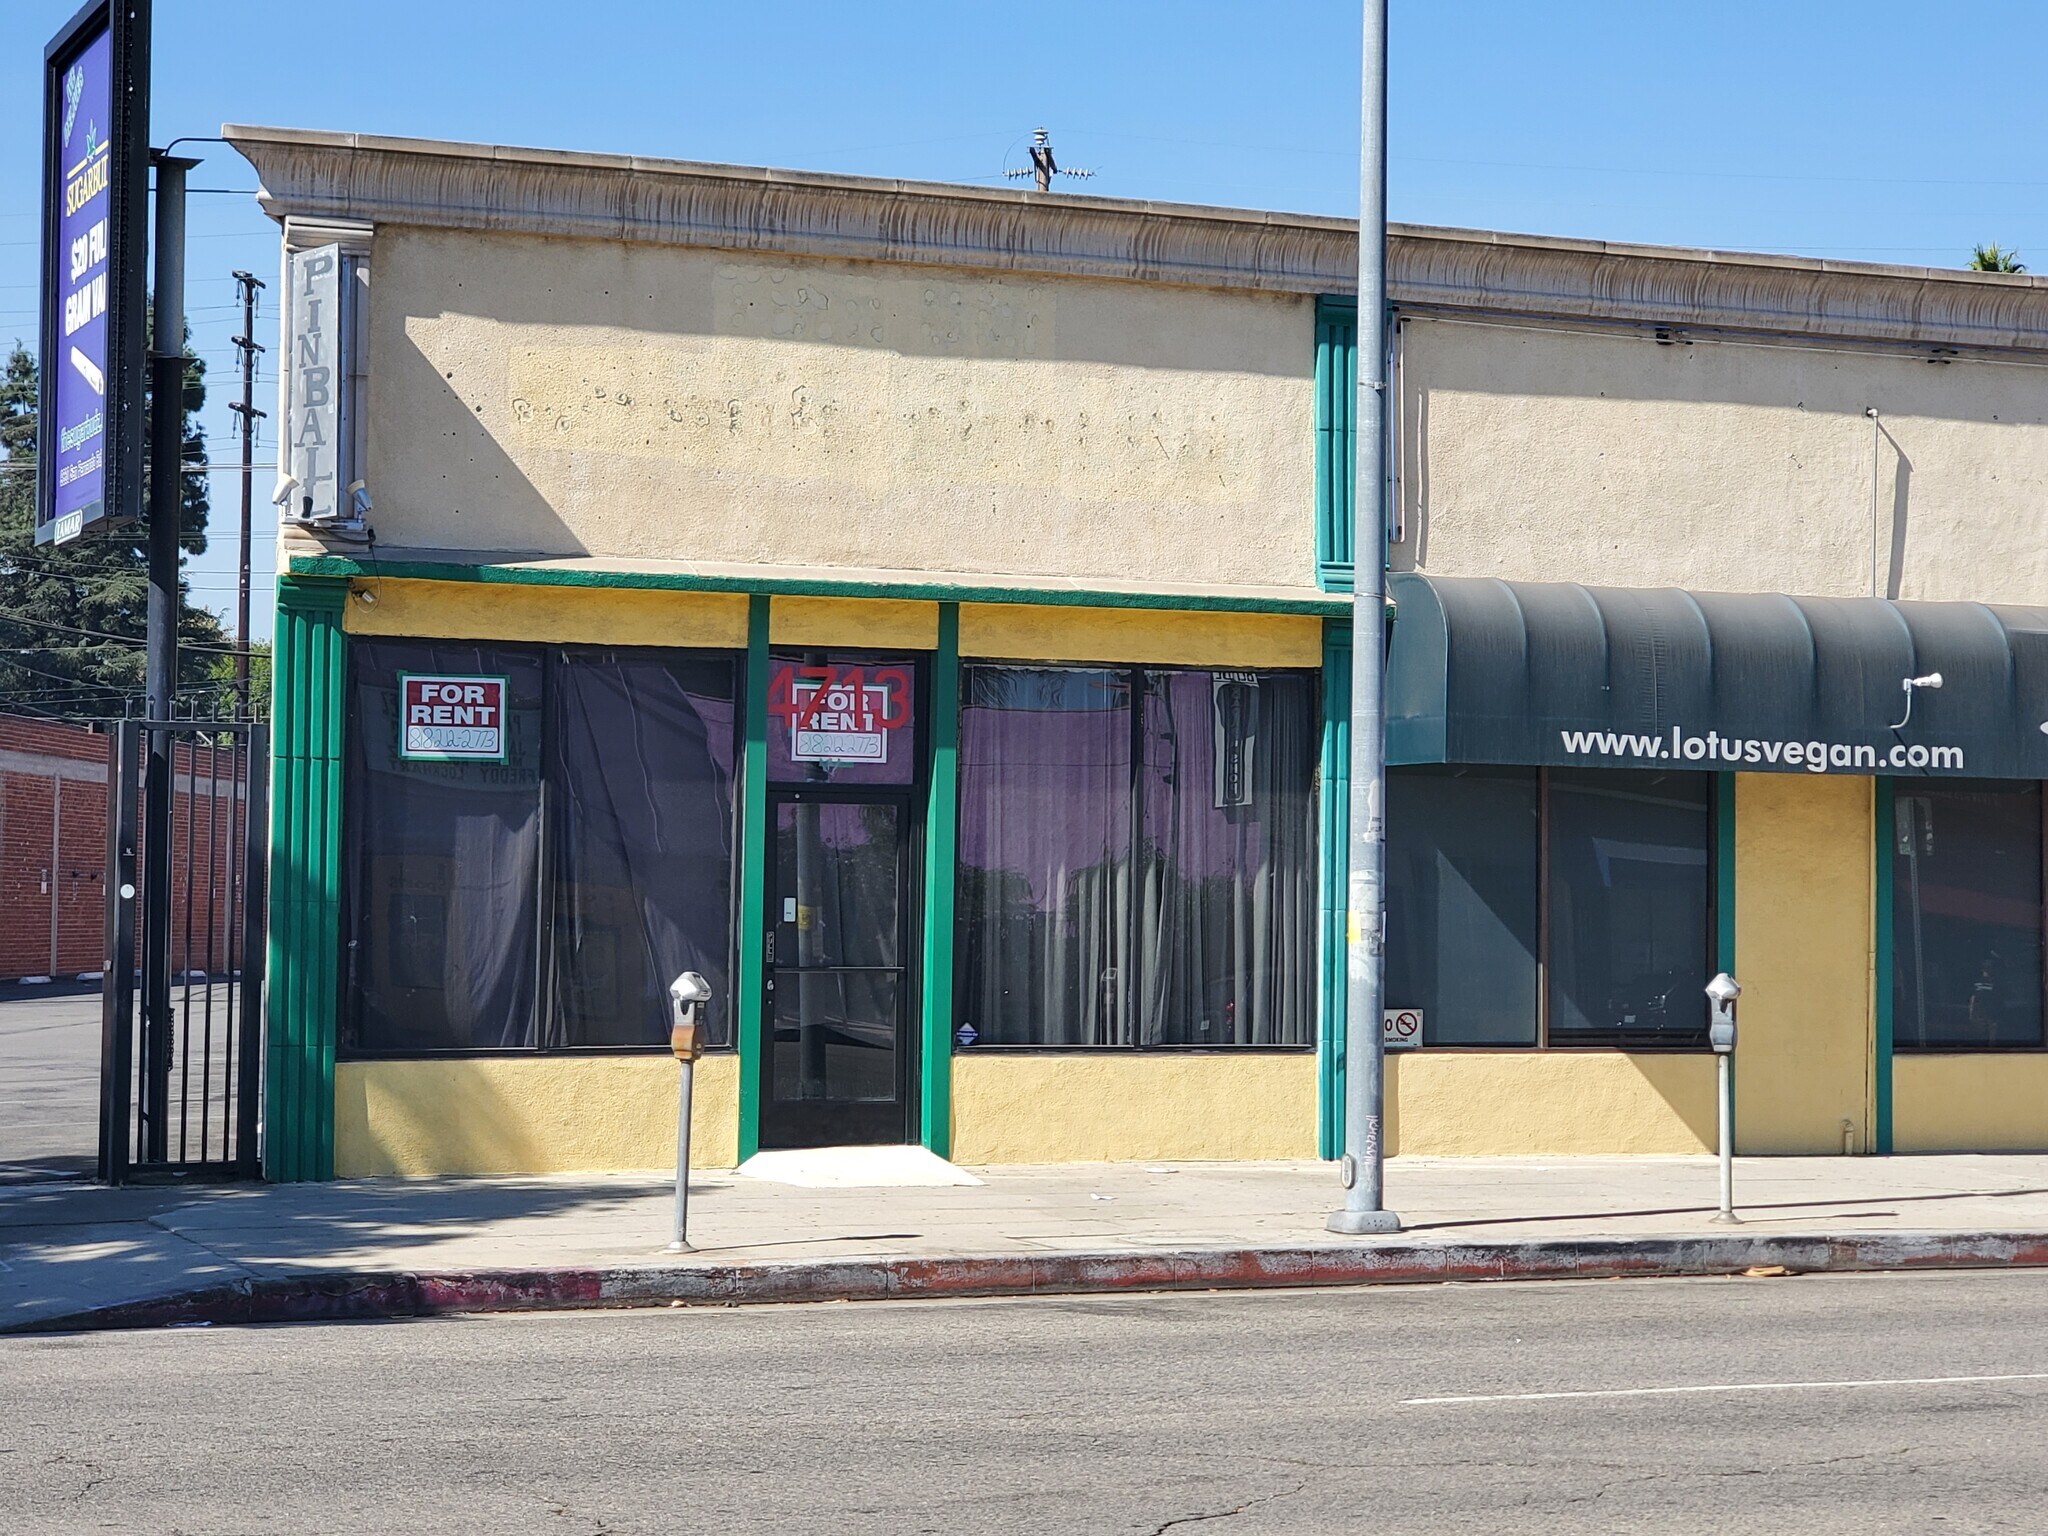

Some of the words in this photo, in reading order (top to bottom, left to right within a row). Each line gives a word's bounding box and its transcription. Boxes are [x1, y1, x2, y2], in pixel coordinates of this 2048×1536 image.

[65, 282, 91, 336] GRAM
[57, 518, 81, 539] LAMAR
[421, 684, 485, 704] FOR
[767, 666, 910, 730] 4713
[410, 704, 496, 725] RENT
[800, 711, 874, 731] RENT
[1561, 725, 1964, 773] www.lotusvegan.com
[1384, 1018, 1393, 1032] O
